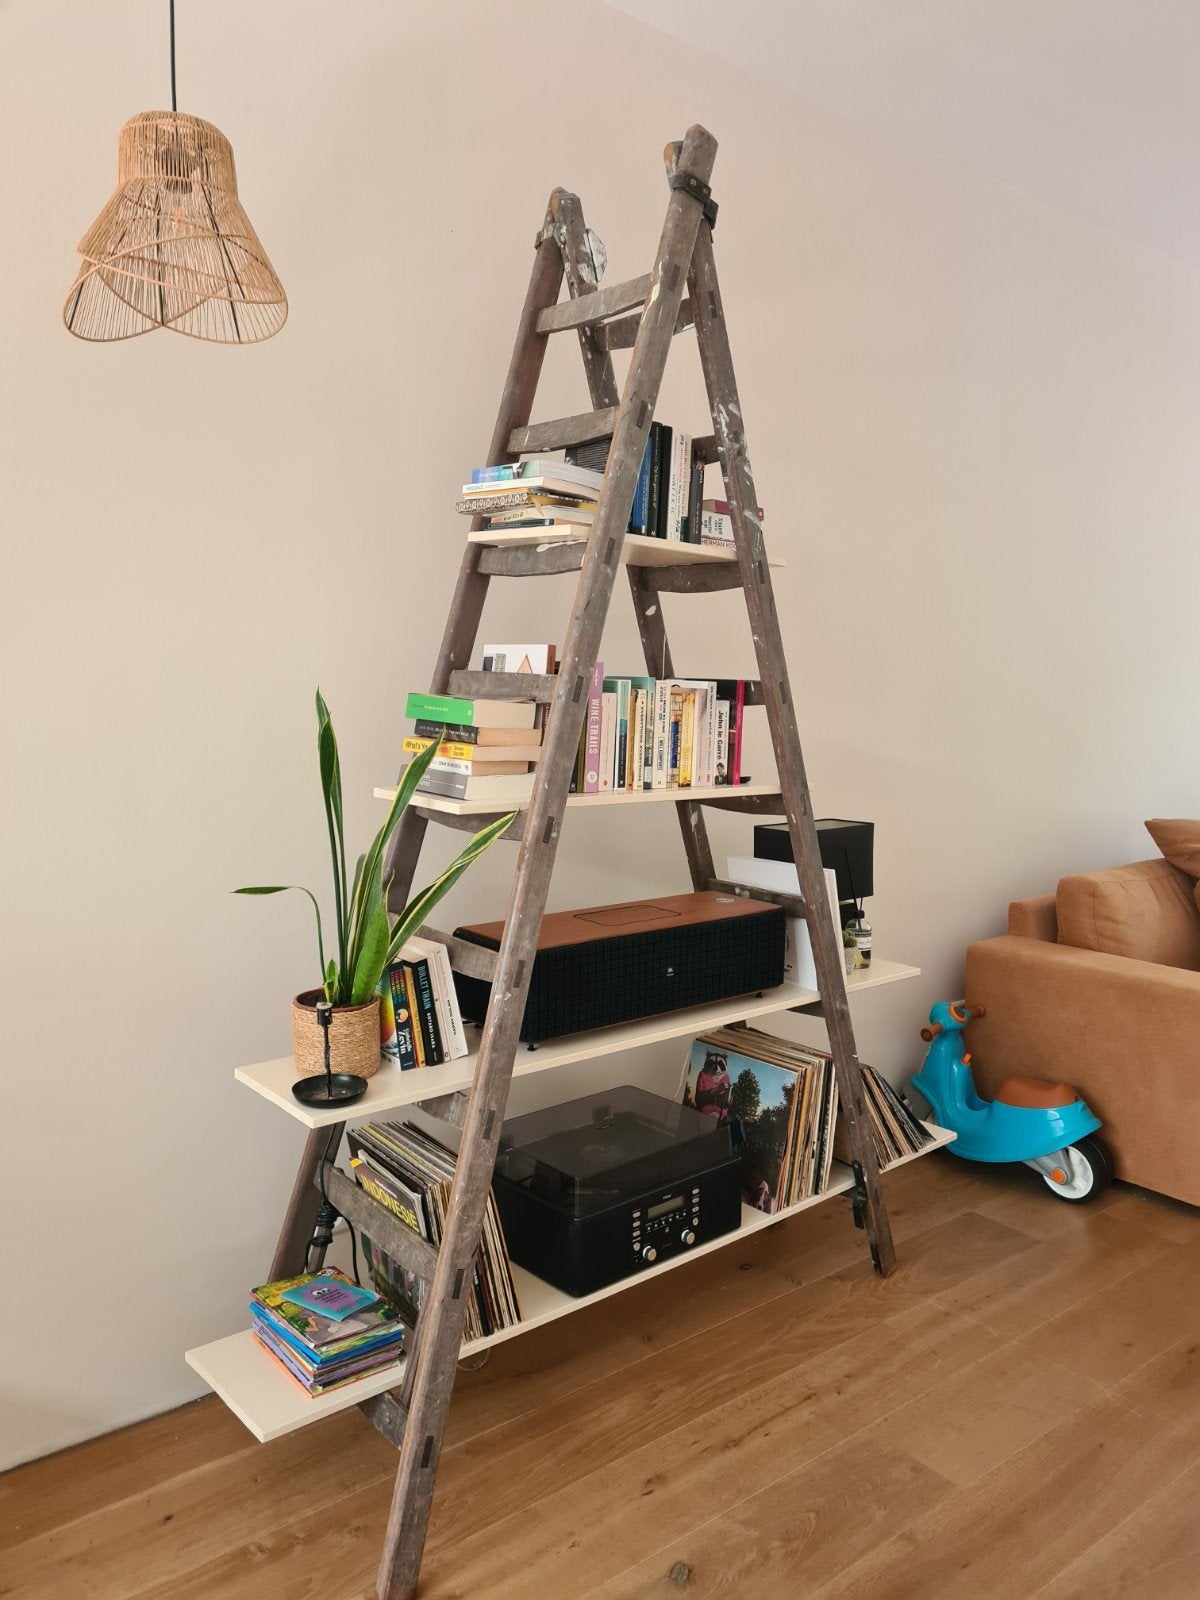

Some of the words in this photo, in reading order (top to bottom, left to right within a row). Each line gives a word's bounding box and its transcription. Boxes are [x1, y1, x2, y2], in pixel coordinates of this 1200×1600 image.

[590, 698, 600, 722] WINE
[589, 724, 599, 754] TRAILS
[418, 965, 428, 989] BULLET
[422, 989, 431, 1010] TRAIN
[397, 1030, 406, 1054] Zevin
